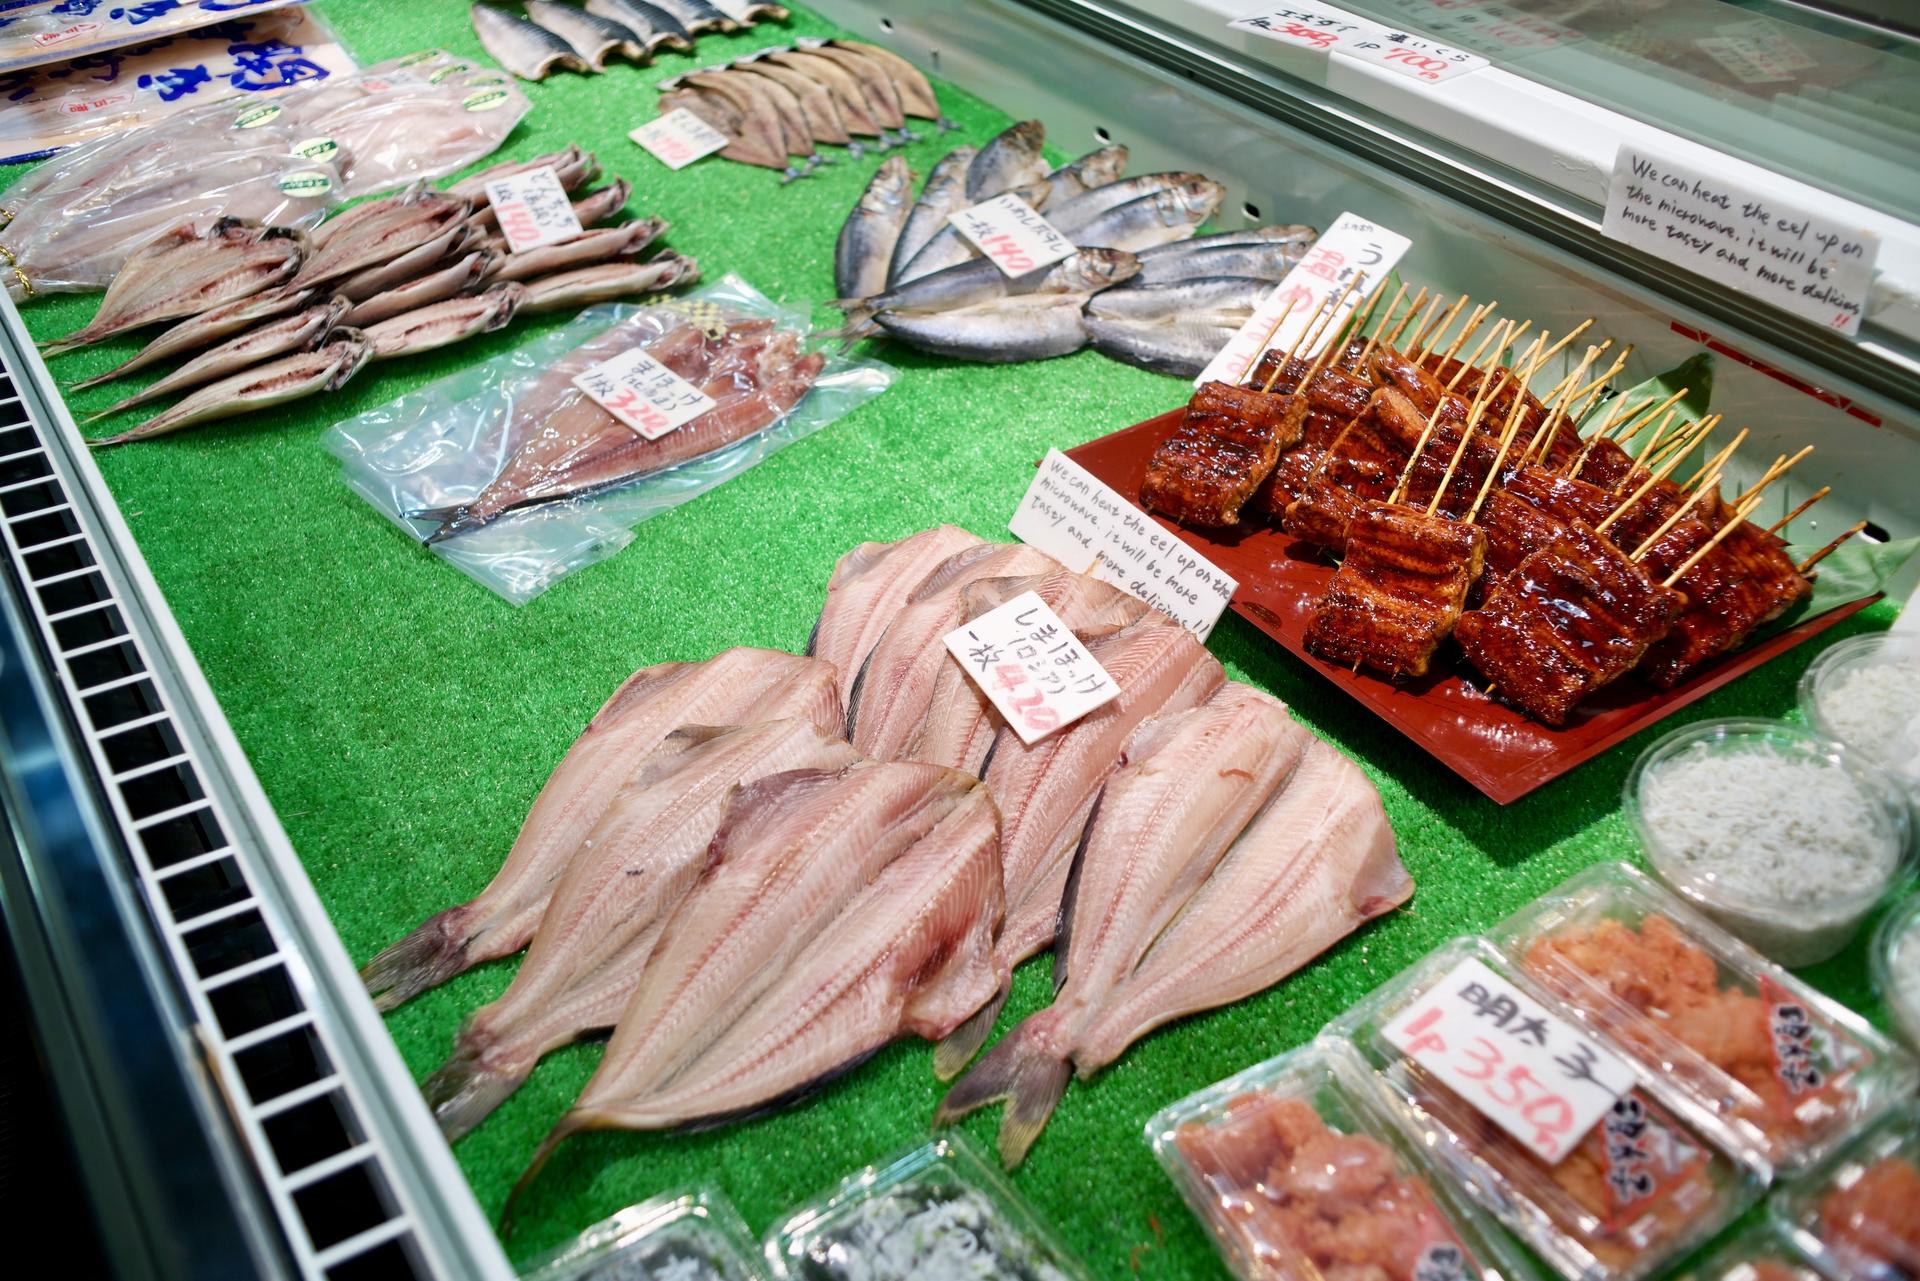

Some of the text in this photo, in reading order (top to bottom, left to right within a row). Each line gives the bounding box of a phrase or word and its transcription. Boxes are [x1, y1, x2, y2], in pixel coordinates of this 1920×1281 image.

[1626, 184, 1653, 206] the
[1747, 228, 1767, 251] it
[1771, 245, 1806, 264] will
[1807, 257, 1830, 280] be
[1631, 155, 1658, 181] We
[1661, 174, 1689, 193] can
[1692, 180, 1732, 210] heat
[1742, 202, 1771, 225] the
[1776, 220, 1810, 241] eel
[981, 234, 1036, 271] 140
[1622, 206, 1657, 232] more
[1666, 223, 1715, 255] tasty
[1756, 264, 1797, 292] more
[605, 387, 671, 435] 320
[1031, 494, 1066, 528] tasty
[1067, 525, 1093, 550] and
[1095, 549, 1126, 580] more
[1050, 460, 1068, 481] We
[1069, 474, 1091, 496] can
[1091, 488, 1120, 518] heat
[1123, 513, 1146, 537] the
[1149, 533, 1178, 559] eel
[1212, 577, 1232, 600] the
[1105, 524, 1121, 544] it
[1121, 540, 1148, 564] will
[1146, 559, 1163, 579] be
[1165, 574, 1200, 606] more
[1014, 607, 1107, 694] しまほっけ
[992, 663, 1061, 731] 420
[1457, 981, 1622, 1100] 明太子
